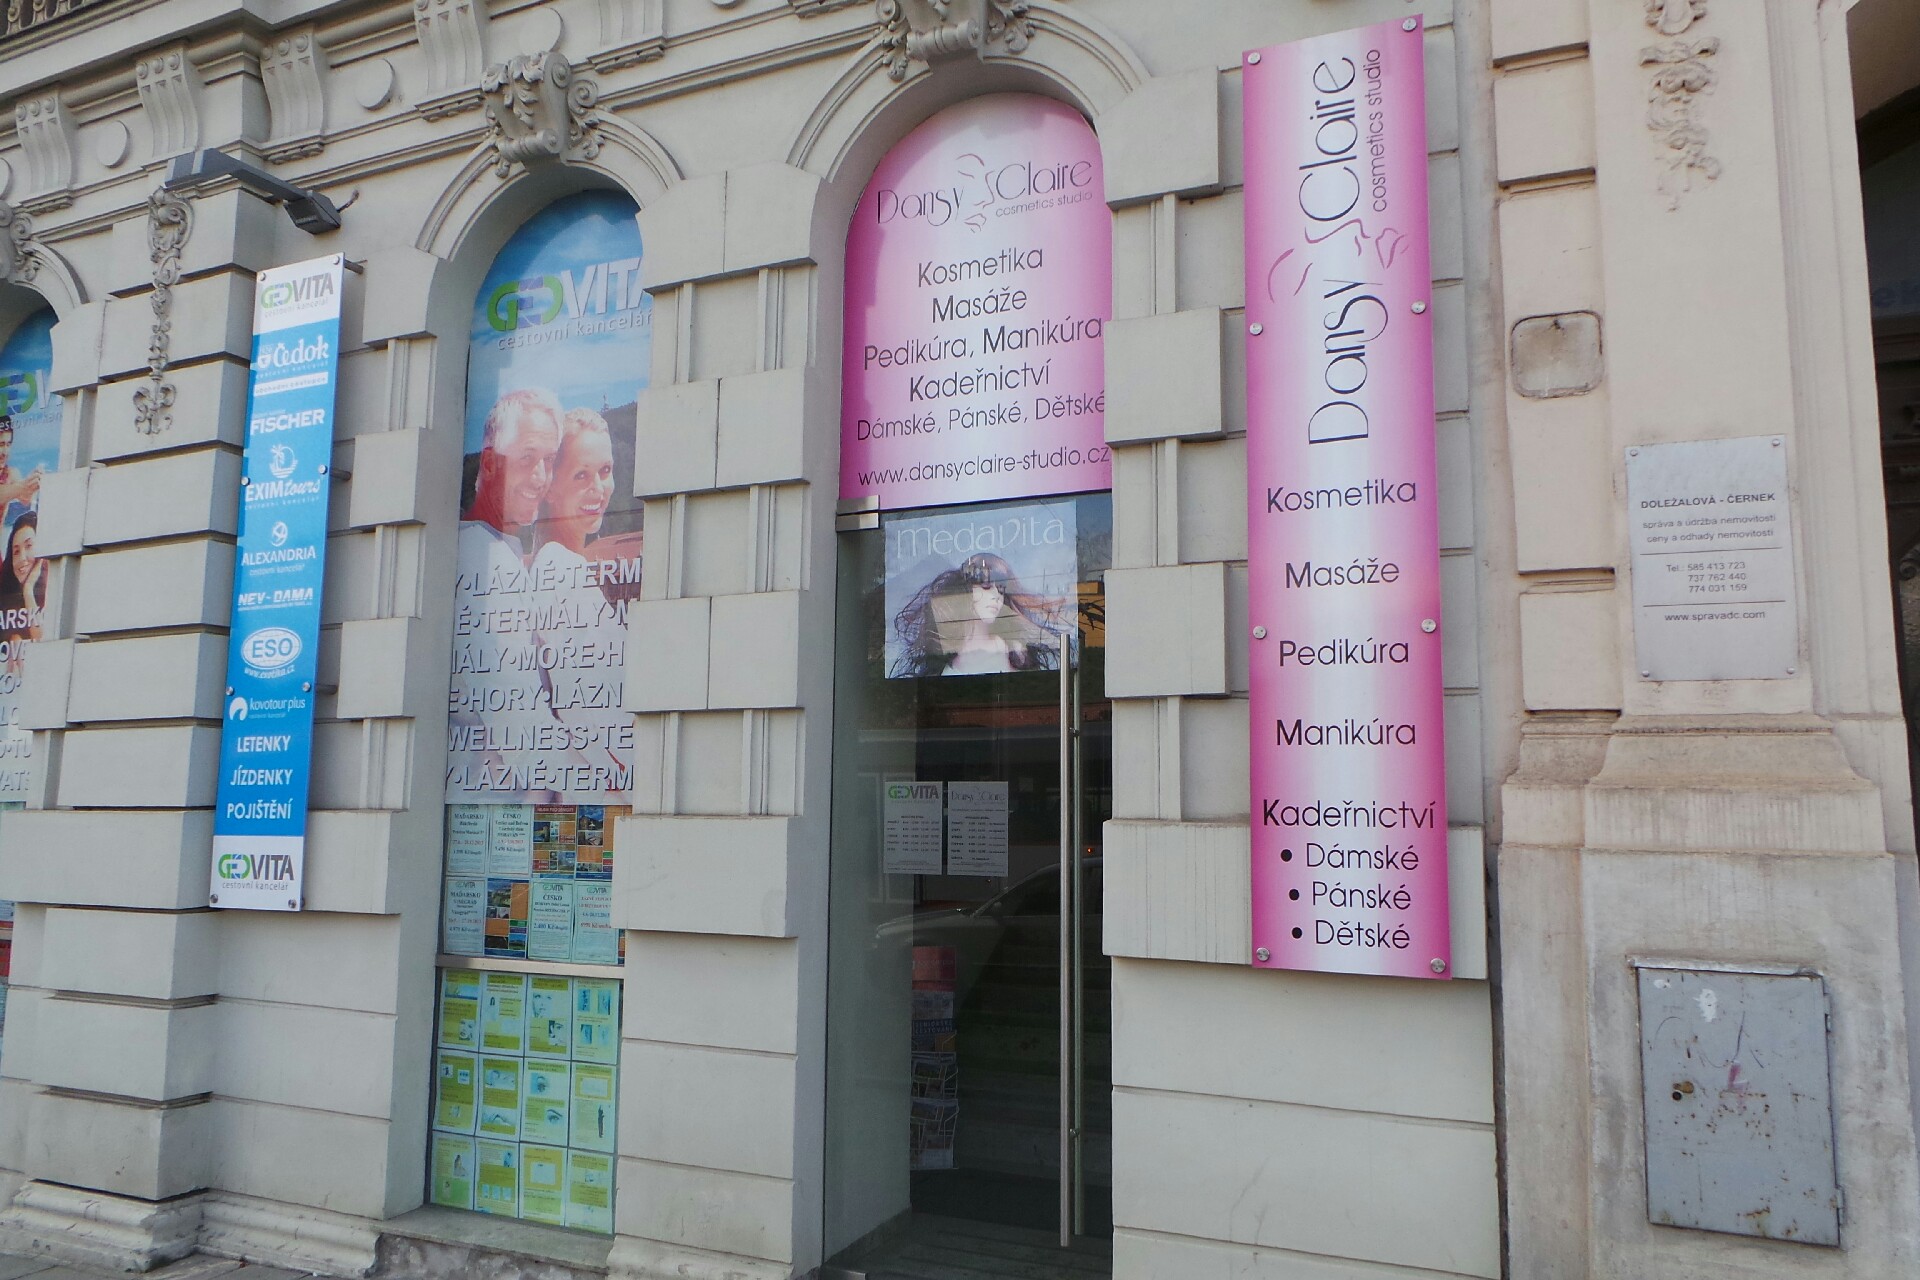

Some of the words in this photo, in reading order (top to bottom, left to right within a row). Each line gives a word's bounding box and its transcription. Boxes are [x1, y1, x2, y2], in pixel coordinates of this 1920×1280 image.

[1363, 48, 1384, 106] studio
[1299, 56, 1361, 222] Claire
[1365, 111, 1388, 213] cosmetics
[995, 159, 1093, 200] Claire
[995, 198, 1055, 218] cosmetics
[1057, 190, 1093, 206] studio
[918, 247, 1044, 288] Kosmetika
[932, 286, 1028, 323] Masáže
[497, 322, 569, 351] cestovní
[864, 335, 975, 370] Pedikúra,
[983, 315, 1102, 354] Manikúra
[273, 334, 329, 368] Čedok
[909, 358, 1052, 402] Kadeřnictví
[250, 408, 325, 436] FISCHER
[857, 411, 943, 441] Dámské,
[949, 403, 1029, 431] Pánské,
[1035, 390, 1105, 420] Dětské
[858, 444, 1110, 486] www.dansyclaire-studio.cz
[1267, 479, 1417, 514] Kosmetika
[1641, 495, 1717, 509] DOLEŽALOVÁ
[1726, 493, 1776, 504] ČERNEK
[1642, 520, 1674, 529] správa
[1685, 516, 1718, 526] údržba
[1646, 535, 1669, 544] ceny
[1680, 532, 1715, 542] odhady
[241, 545, 317, 567] ALEXANDRIA
[1687, 563, 1705, 572] 585
[1706, 562, 1725, 571] 413
[1728, 561, 1746, 570] 723
[1285, 557, 1400, 589] Masáže
[1687, 574, 1705, 583] 737
[1708, 573, 1726, 582] 762
[1728, 572, 1747, 581] 440
[1689, 585, 1706, 593] 774
[1708, 584, 1726, 592] 031
[1729, 583, 1747, 591] 159
[1664, 611, 1766, 622] www.spravadc.com
[252, 637, 293, 659] ESO
[1279, 637, 1410, 667] Pedikúra
[249, 698, 286, 711] kovotour
[287, 696, 306, 712] plus
[237, 735, 291, 753] LETENKY
[1276, 718, 1417, 746] Manikúra
[230, 764, 294, 787] JÍZDENKY
[226, 797, 294, 820] POJIŠTĚNÍ
[1263, 798, 1436, 829] Kadeřnictví
[1306, 843, 1419, 871] Dámské
[222, 880, 254, 889] cestovní
[255, 881, 289, 891] kancelář
[1312, 881, 1412, 911] Pánské
[1314, 919, 1411, 949] Dětské
